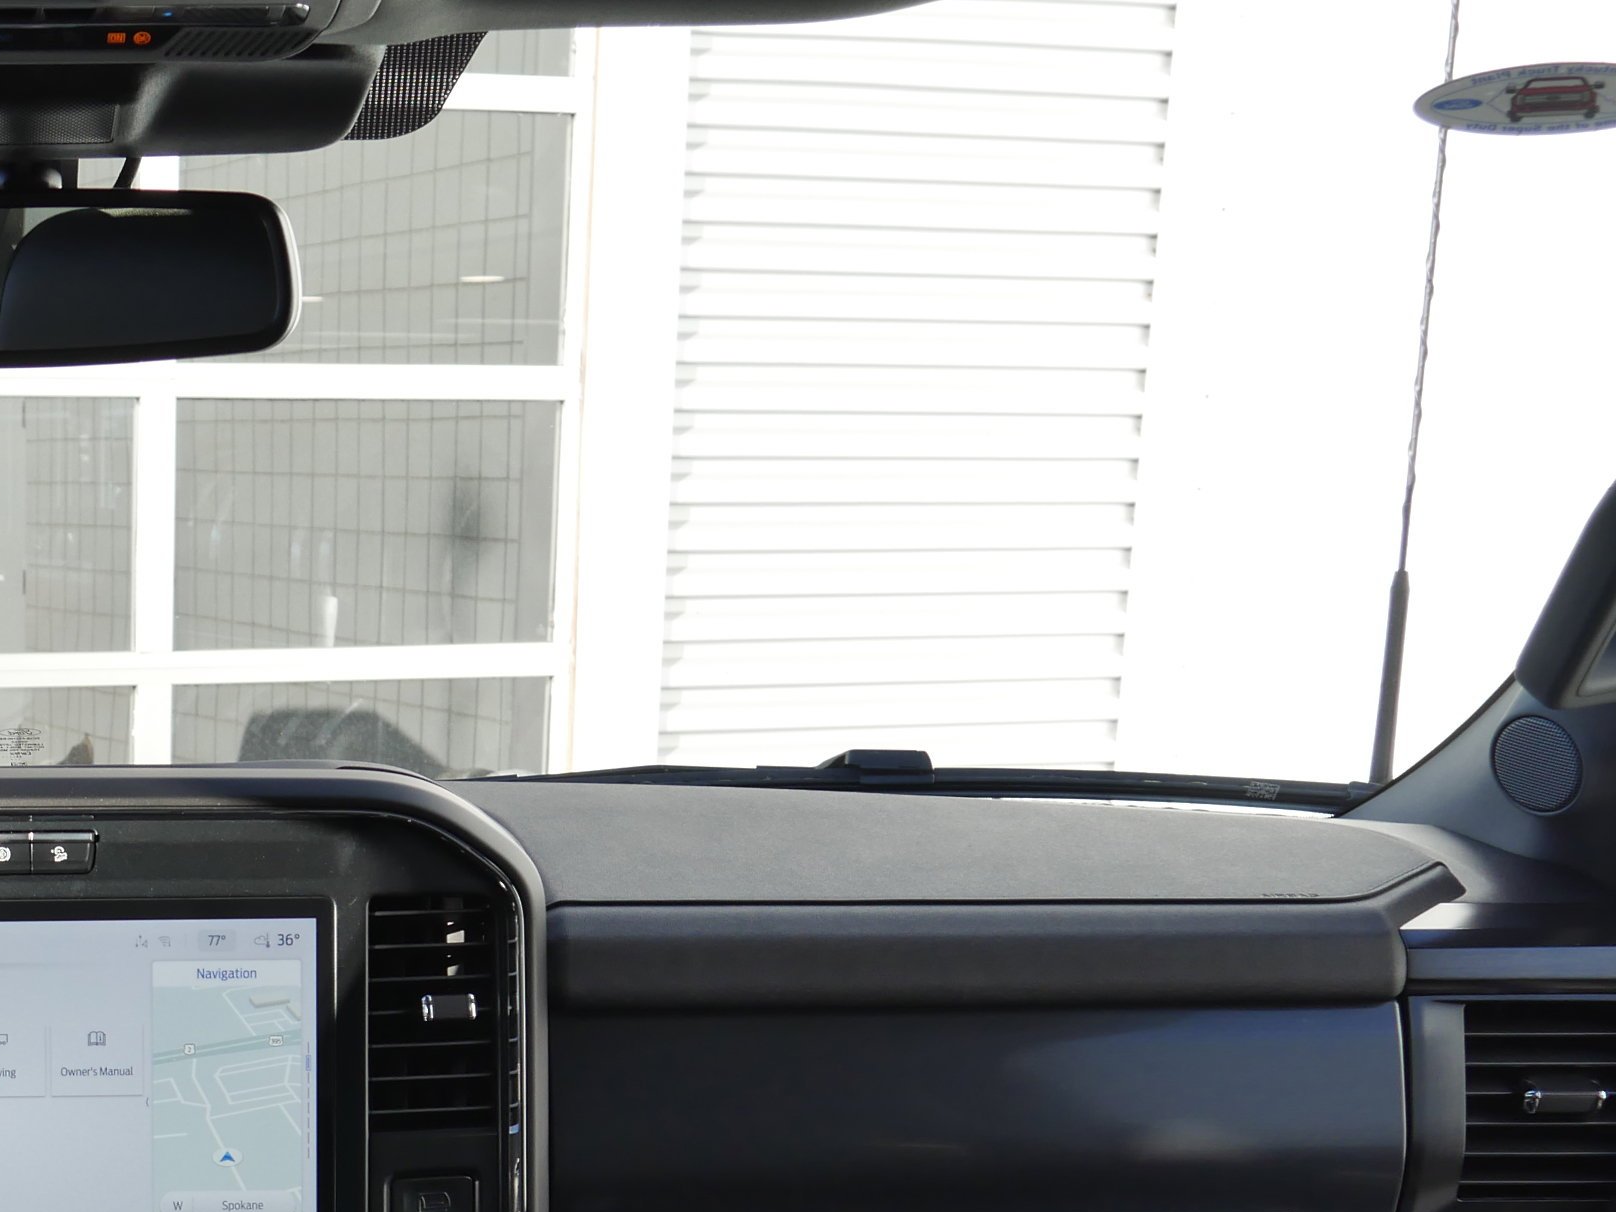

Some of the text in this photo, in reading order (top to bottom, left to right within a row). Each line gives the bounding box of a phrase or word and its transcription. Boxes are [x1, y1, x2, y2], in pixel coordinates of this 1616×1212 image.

[207, 935, 226, 947] 77°
[277, 933, 300, 946] 36°
[196, 968, 257, 981] Navigation
[60, 1066, 134, 1078] Owner's Manual
[172, 1201, 183, 1210] W
[222, 1200, 264, 1212] Spokane
